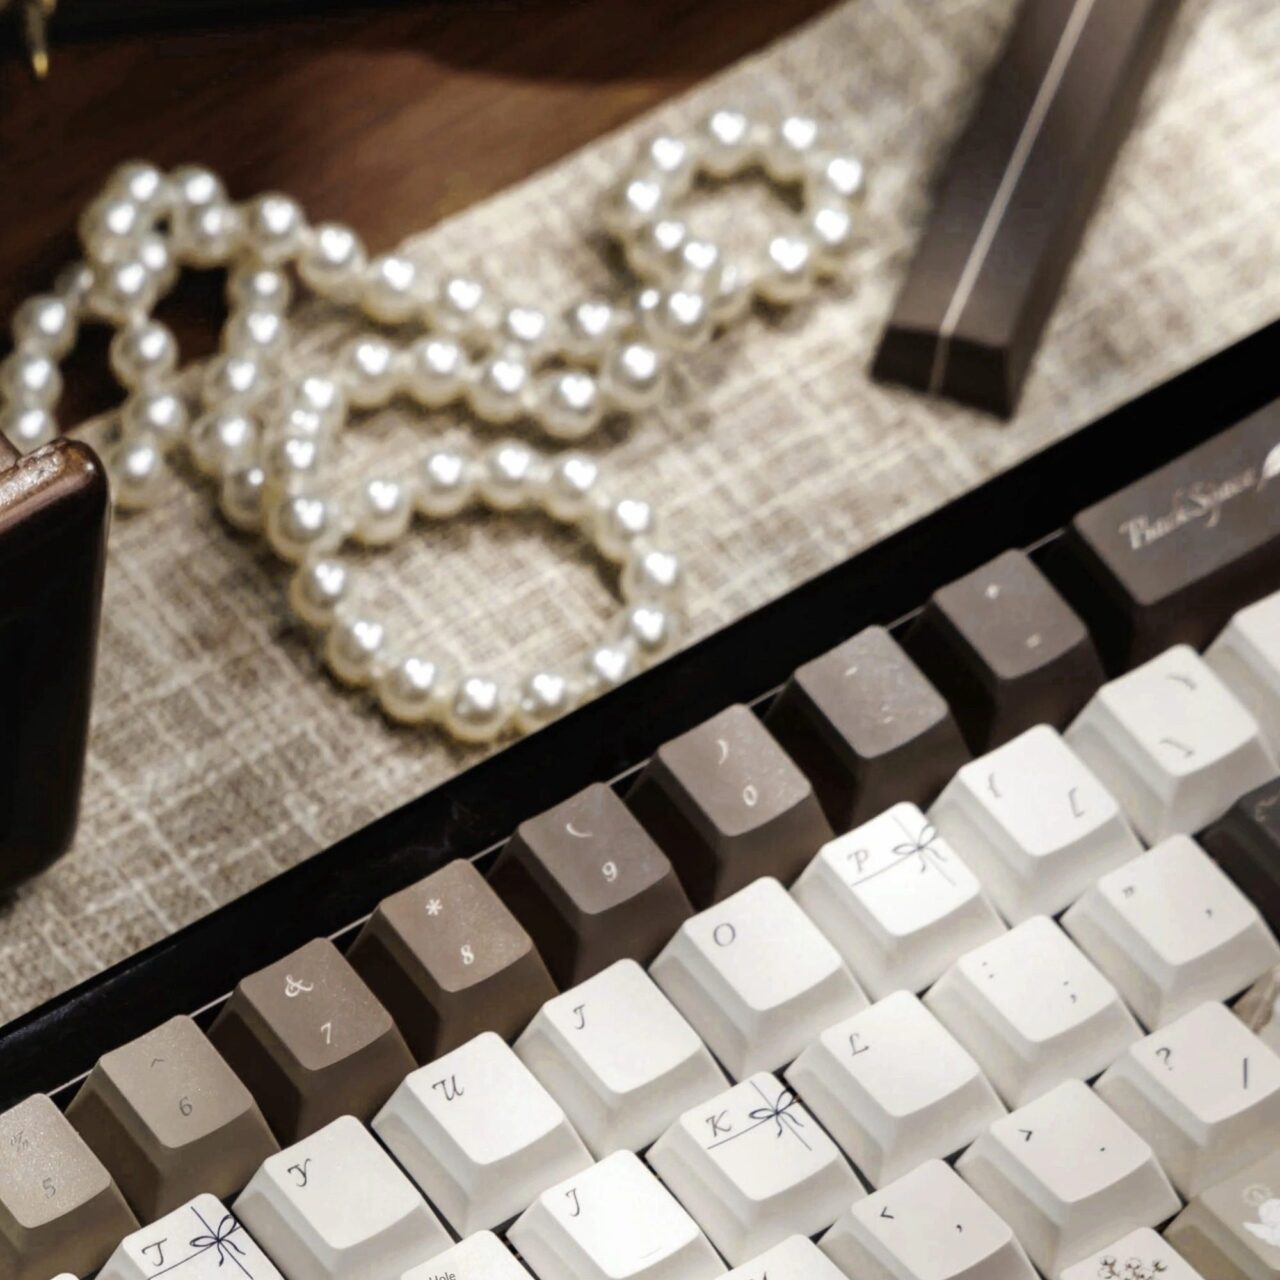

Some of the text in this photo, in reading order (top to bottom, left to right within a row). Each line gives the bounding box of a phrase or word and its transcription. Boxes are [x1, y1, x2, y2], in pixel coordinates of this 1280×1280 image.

[601, 860, 618, 883] 9
[712, 922, 737, 948] O
[460, 944, 475, 965] 8
[284, 974, 314, 998] &
[320, 1021, 332, 1045] 7
[431, 1074, 464, 1102] U
[178, 1095, 193, 1117] 6
[705, 1110, 734, 1138] K
[1020, 1129, 1033, 1142] >
[286, 1158, 311, 1188] Y
[41, 1176, 57, 1200] 5
[879, 1206, 895, 1220] <
[140, 1237, 168, 1267] T
